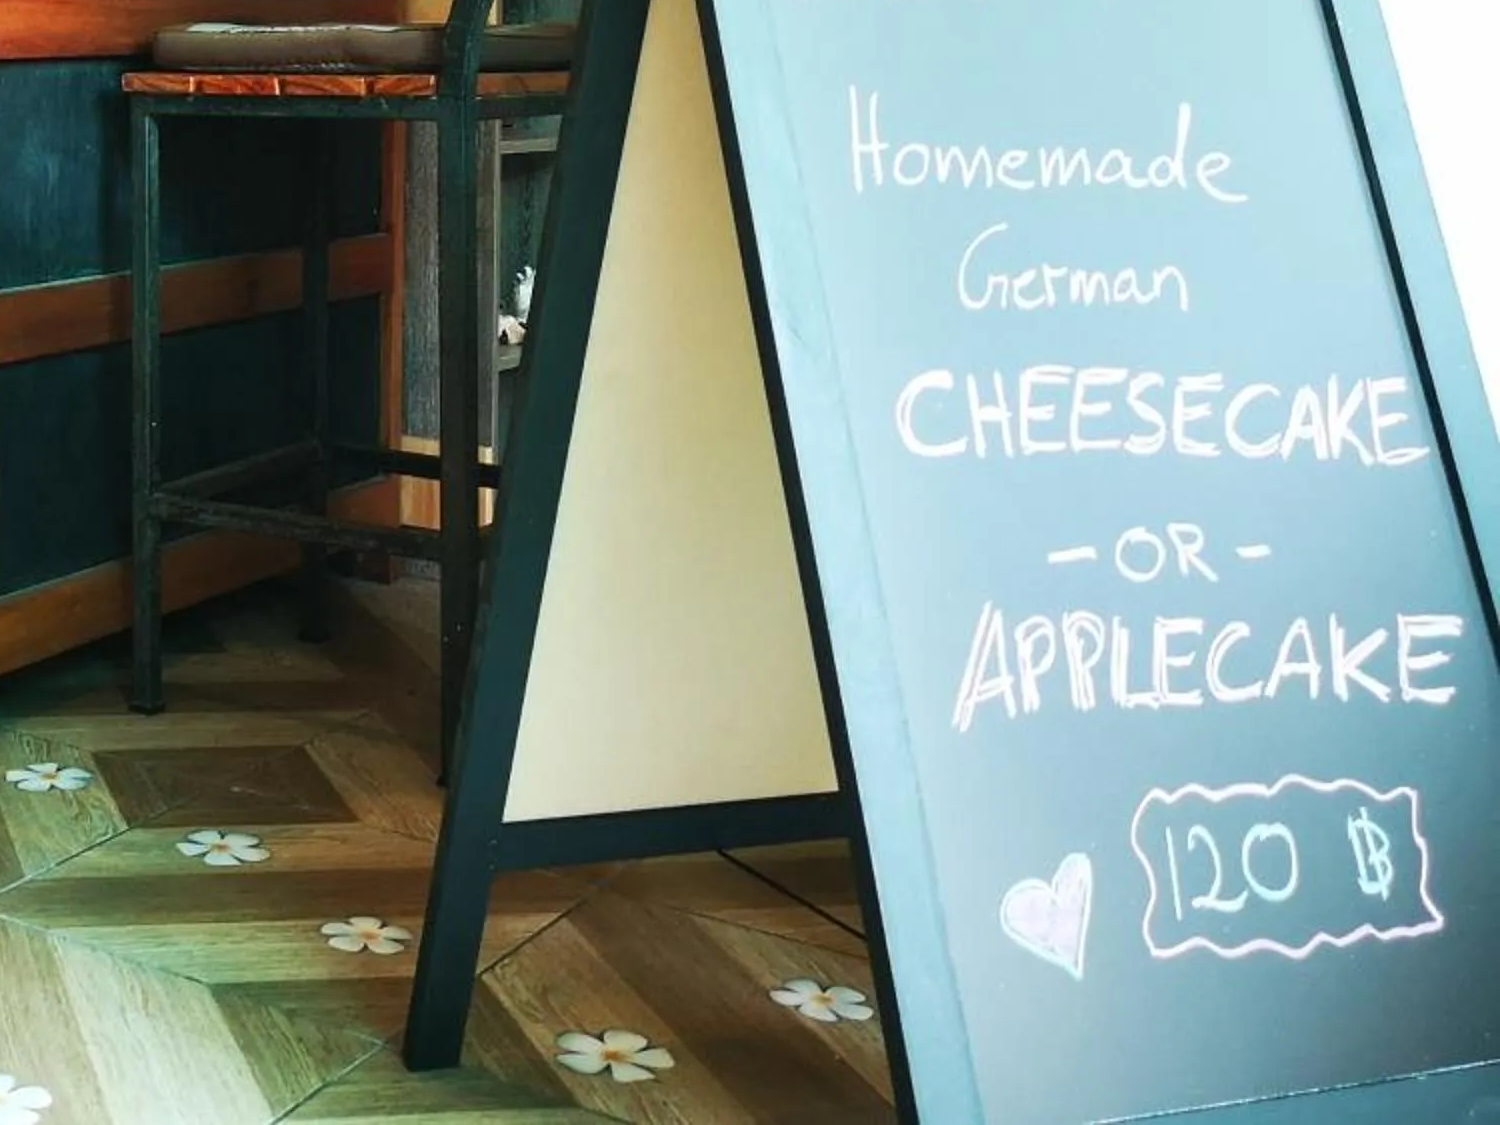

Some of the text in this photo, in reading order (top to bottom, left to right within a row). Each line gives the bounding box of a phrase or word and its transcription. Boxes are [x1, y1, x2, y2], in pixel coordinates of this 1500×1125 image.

[848, 83, 1249, 203] Homemade
[957, 223, 1189, 312] German
[894, 363, 1429, 467] CHEESECAKE
[952, 600, 1464, 733] APPLECAKE
[1164, 821, 1299, 921] 120
